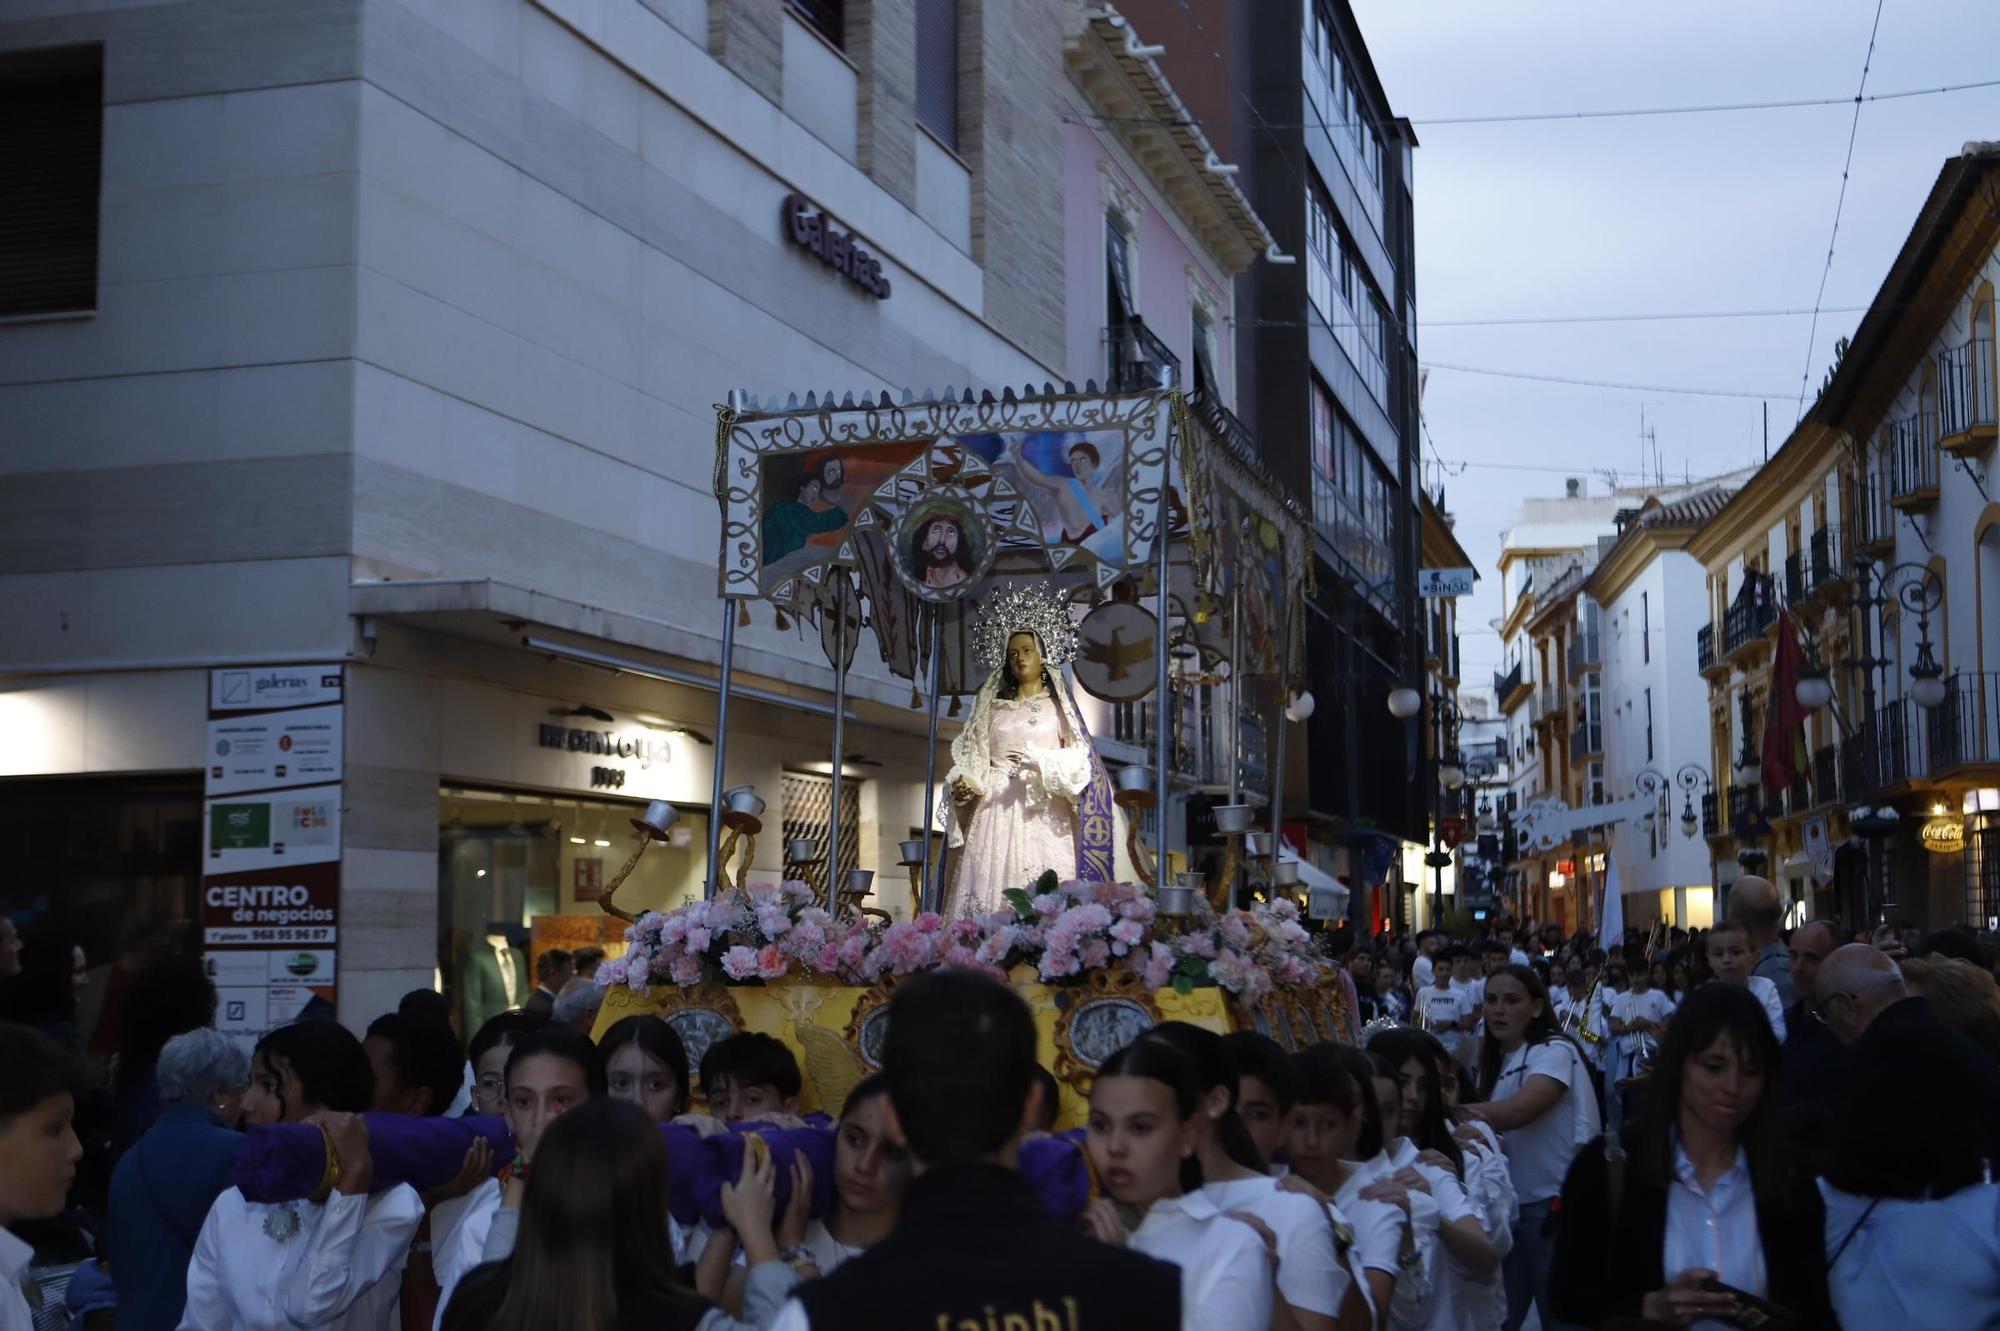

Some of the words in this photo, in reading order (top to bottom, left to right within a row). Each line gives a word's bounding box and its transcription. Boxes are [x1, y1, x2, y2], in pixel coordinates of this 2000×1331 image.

[206, 885, 309, 907] CENTRO
[232, 908, 254, 922] de
[258, 905, 334, 924] negocios
[277, 930, 292, 940] 95
